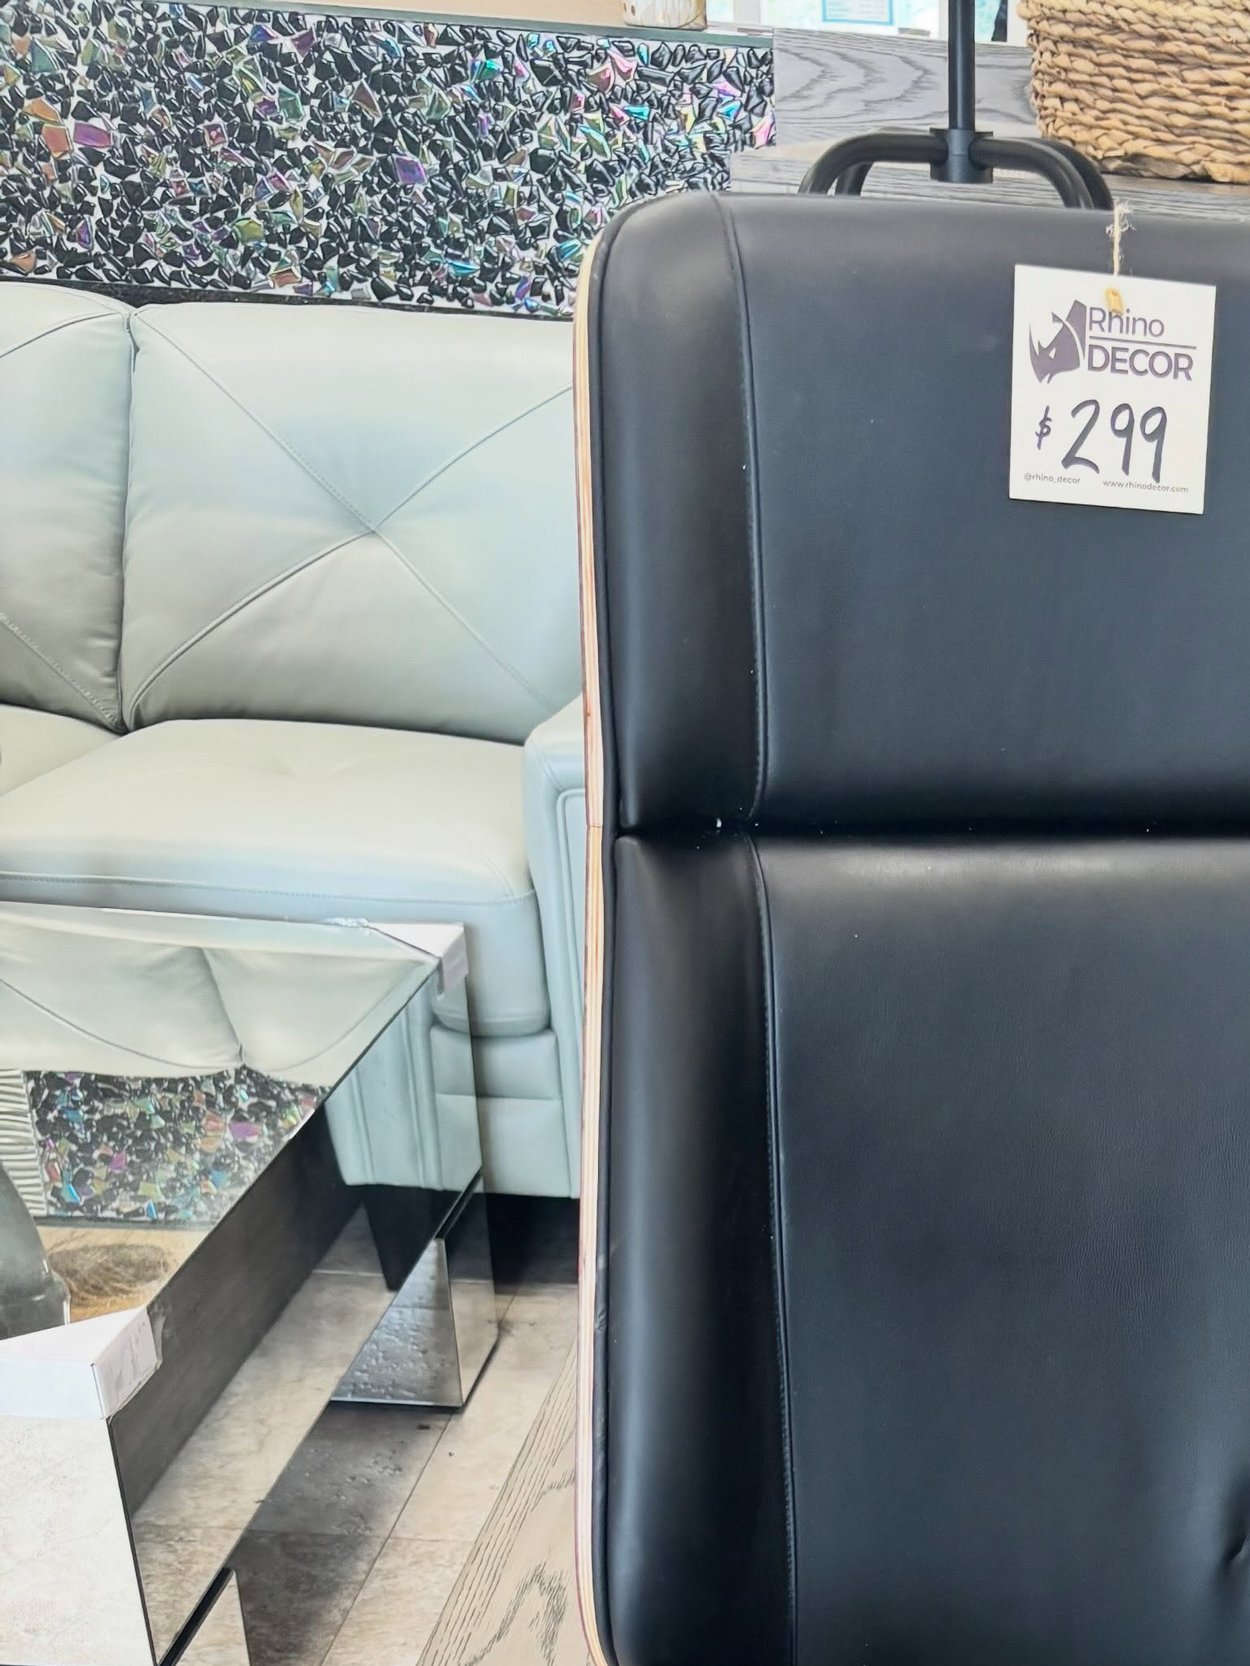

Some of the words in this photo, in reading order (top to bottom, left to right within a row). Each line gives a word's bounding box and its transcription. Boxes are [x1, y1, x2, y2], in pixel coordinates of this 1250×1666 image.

[1088, 306, 1165, 338] Rhino
[1087, 344, 1194, 381] DECOR
[1035, 399, 1168, 484] $299
[1102, 480, 1189, 494] www.rhinodecor.com
